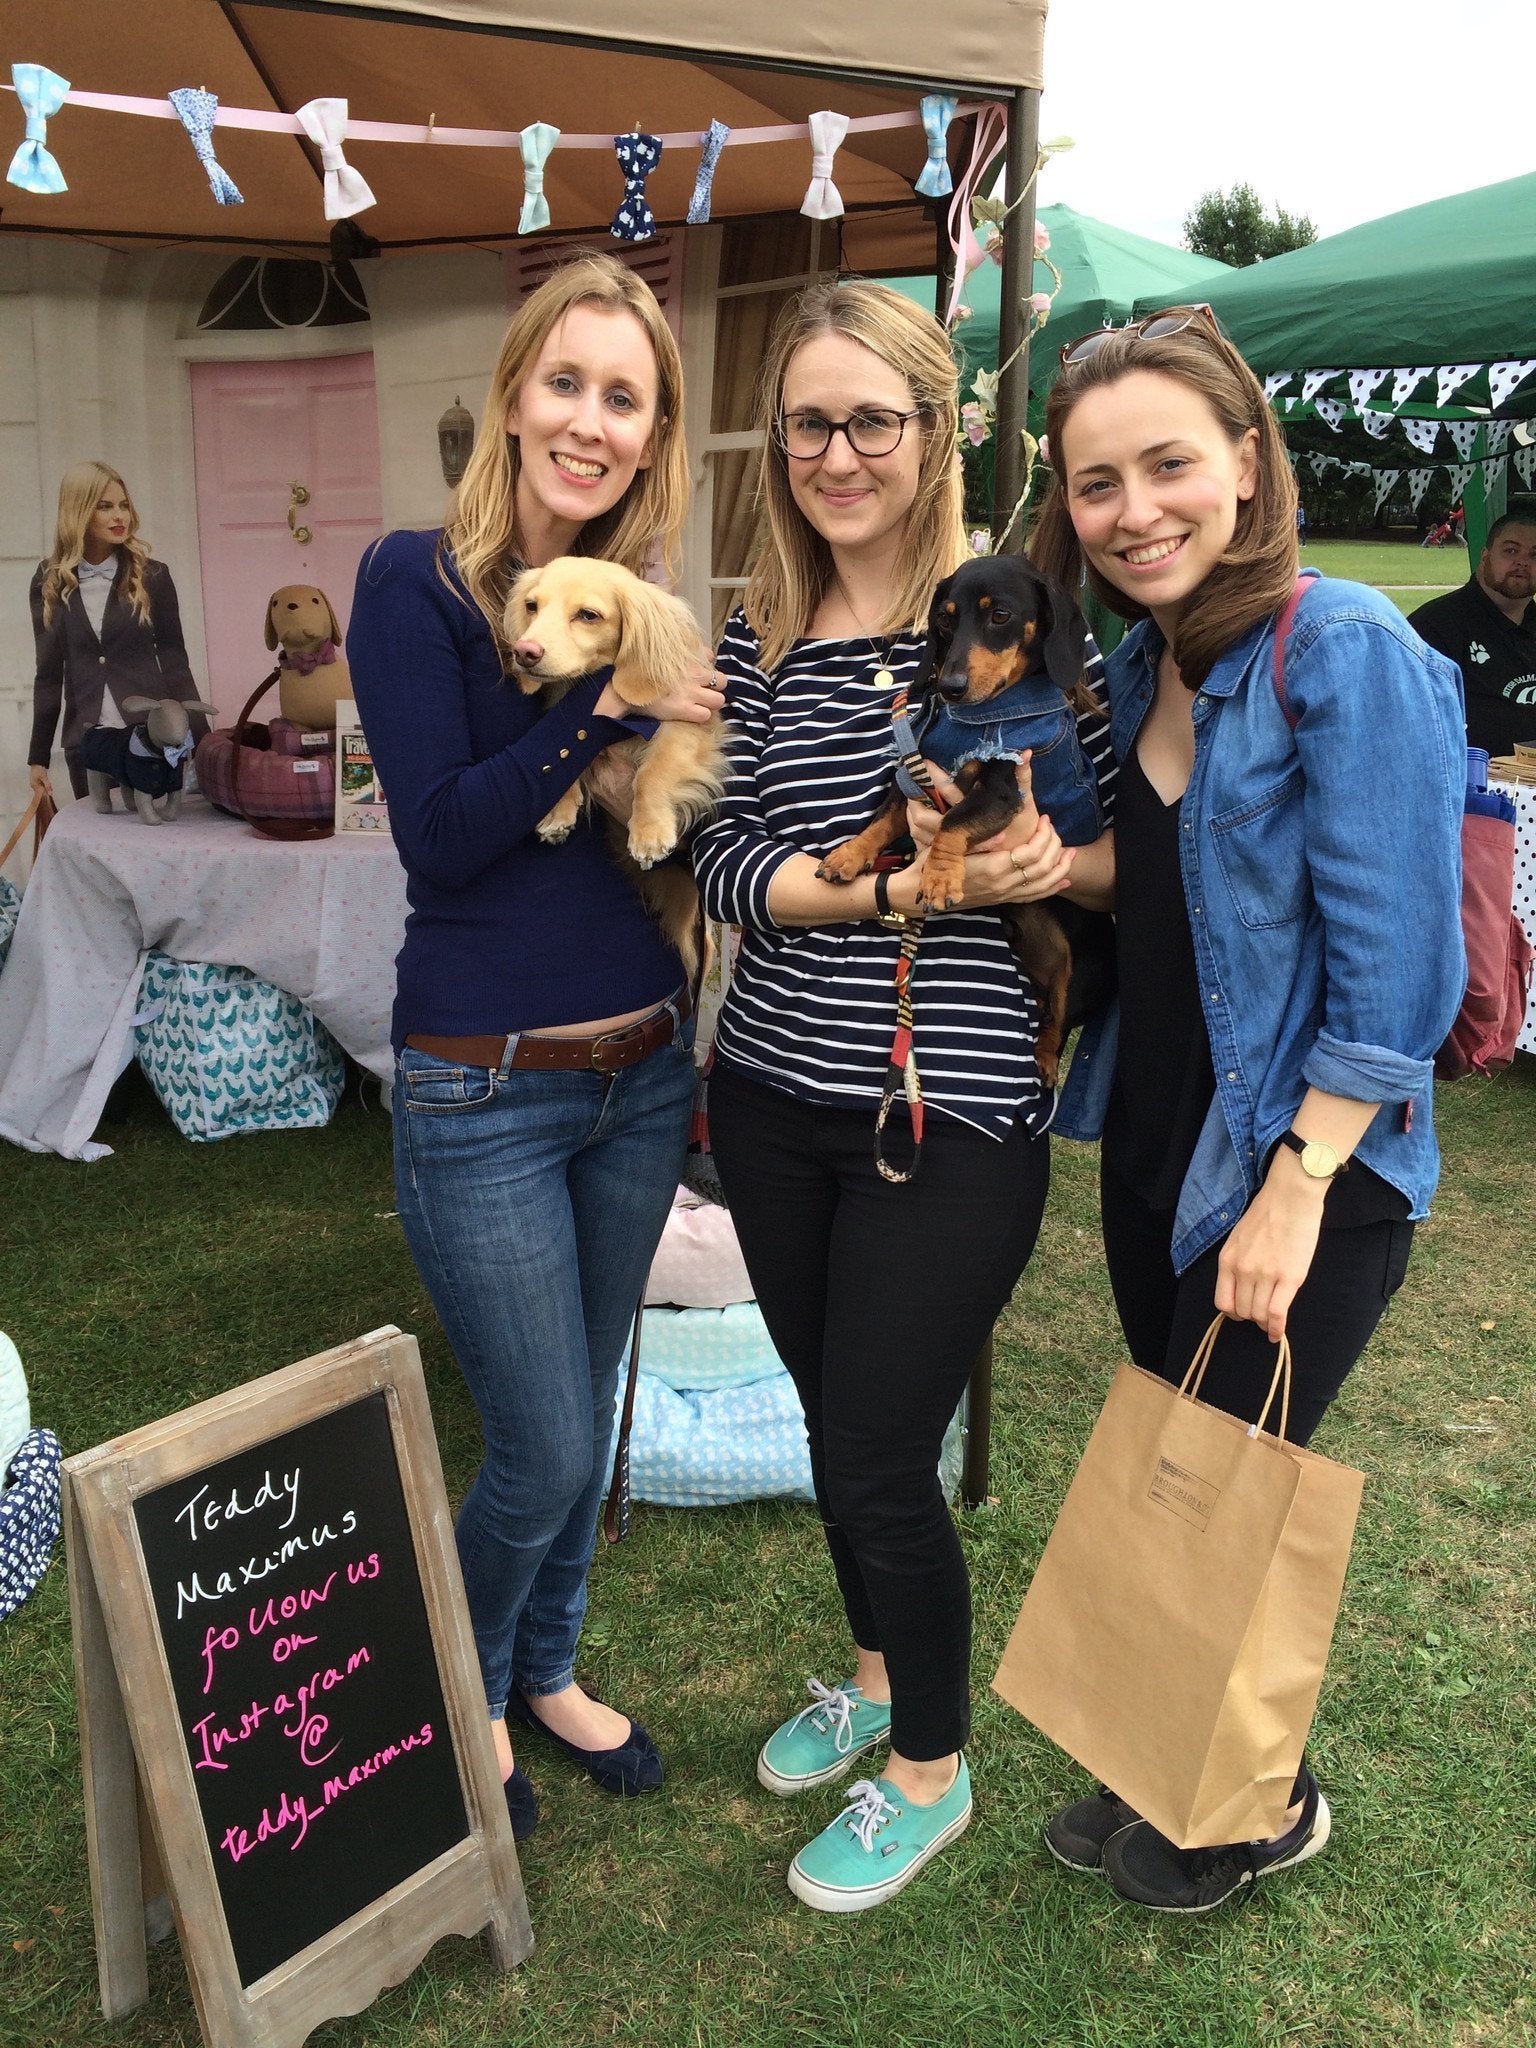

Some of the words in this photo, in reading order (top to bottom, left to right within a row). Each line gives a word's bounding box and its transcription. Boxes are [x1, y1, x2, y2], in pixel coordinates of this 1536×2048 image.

[176, 1510, 357, 1620] Maximus
[201, 1571, 338, 1694] follow
[347, 1553, 381, 1584] us
[272, 1634, 318, 1663] on
[192, 1647, 371, 1770] Instagram
[300, 1714, 345, 1767] @
[220, 1723, 434, 1862] teddy_maximus
